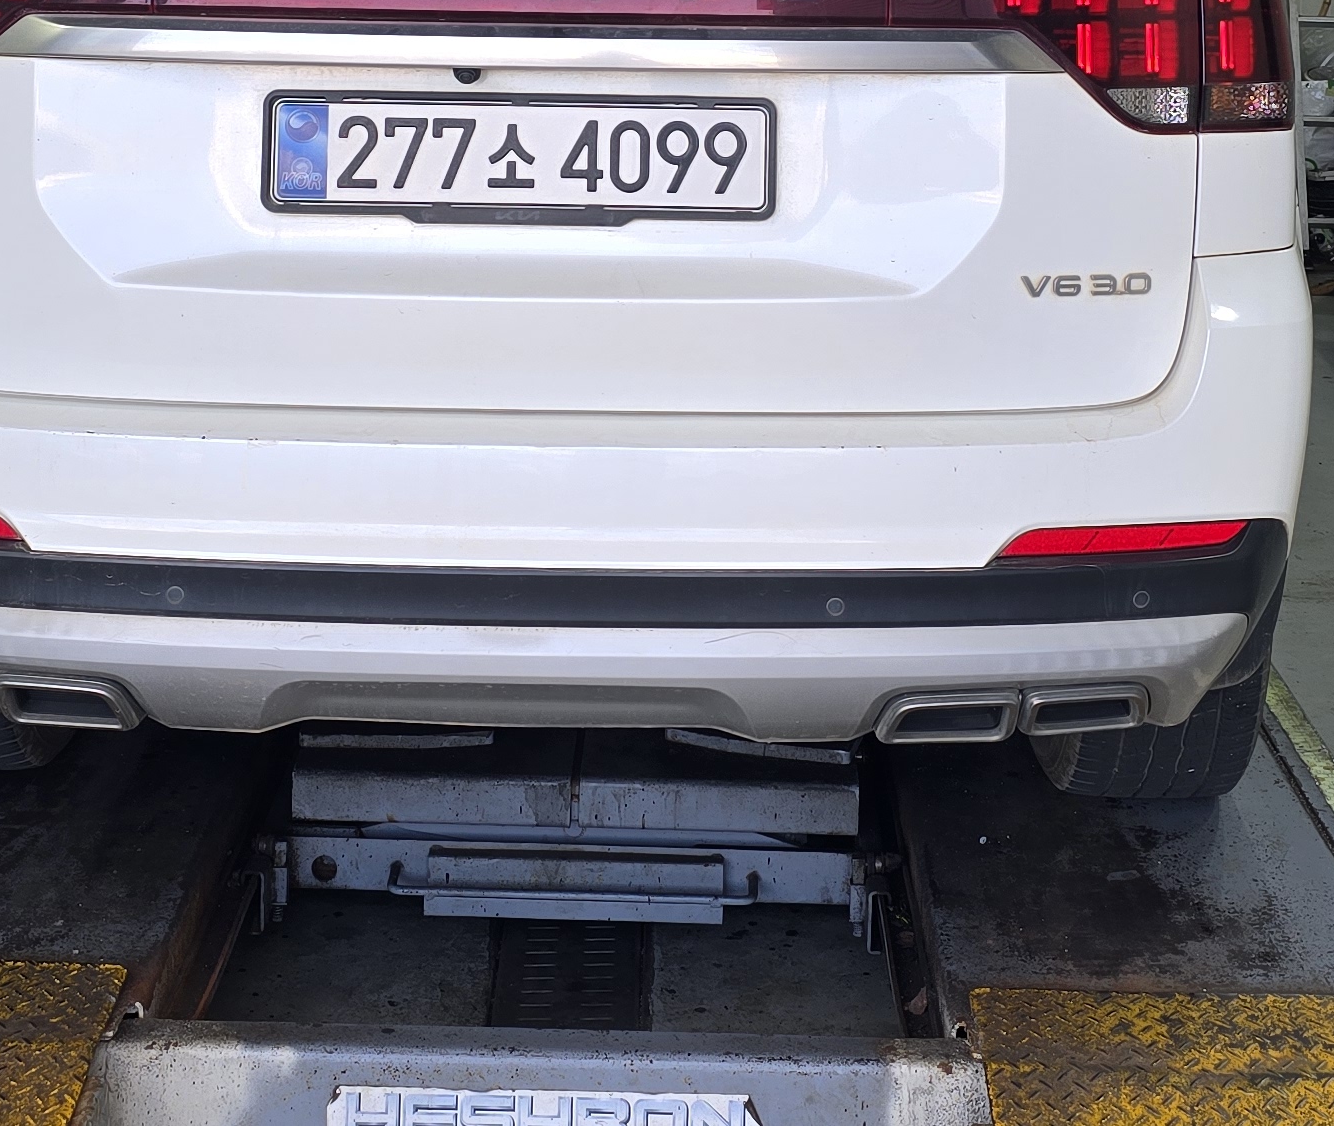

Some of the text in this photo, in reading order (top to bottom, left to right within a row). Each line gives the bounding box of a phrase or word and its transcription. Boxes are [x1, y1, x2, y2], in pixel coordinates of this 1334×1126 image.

[336, 115, 748, 195] 277소 4099
[280, 172, 323, 190] KOR
[1021, 275, 1082, 298] V6
